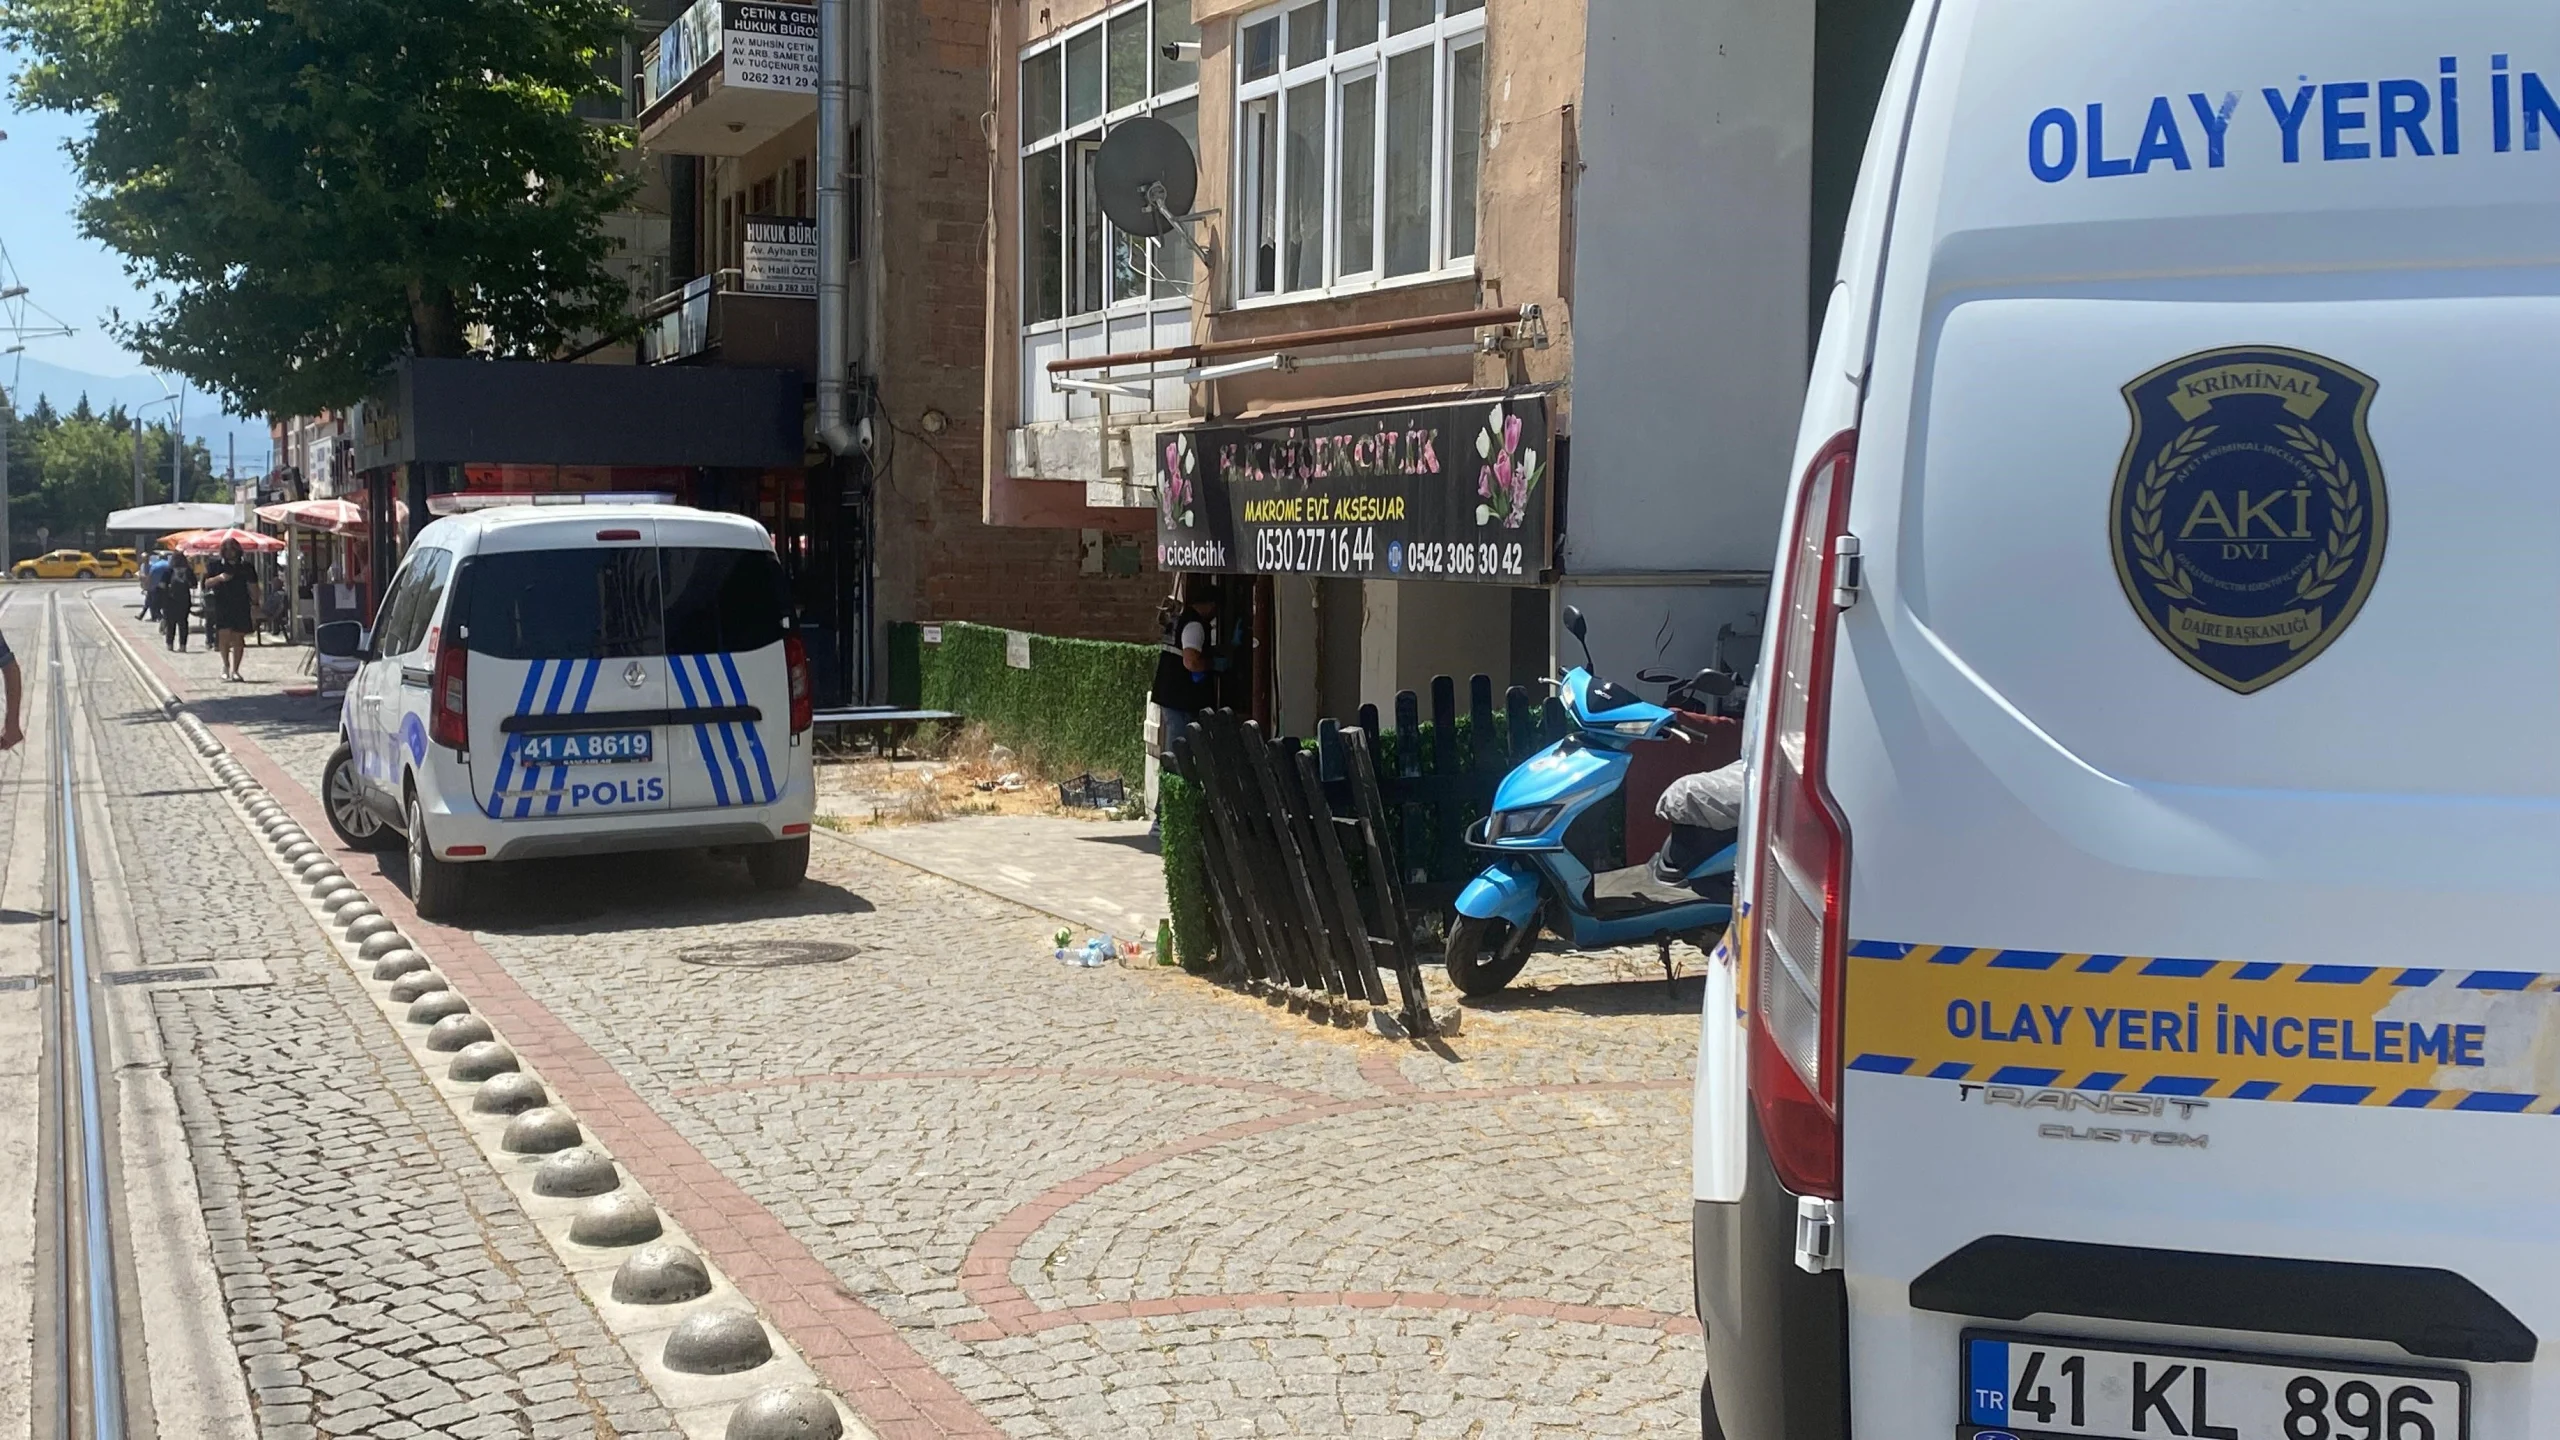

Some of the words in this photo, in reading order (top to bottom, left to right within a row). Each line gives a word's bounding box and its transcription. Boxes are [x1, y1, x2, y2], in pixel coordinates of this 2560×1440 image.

[734, 20, 777, 34] HUKUK
[741, 6, 776, 20] ÇETİN
[779, 11, 788, 22] &
[790, 12, 818, 24] GEN
[732, 36, 746, 46] AV.
[749, 38, 784, 50] MUHSİN
[787, 42, 814, 52] ÇETİN
[748, 49, 770, 58] ARB.
[773, 51, 804, 62] SAMET
[732, 58, 746, 66] AV.
[749, 58, 800, 71] TUĞÇENUR
[742, 72, 768, 83] 0262
[772, 75, 791, 85] 321
[795, 76, 808, 87] 29
[2028, 89, 2244, 184] OLAY
[2262, 56, 2459, 164] YERİ
[747, 223, 785, 242] HUKUK
[750, 246, 764, 254] Av.
[767, 246, 798, 257] Ayhan
[801, 248, 817, 257] ER
[750, 264, 764, 274] Av.
[768, 265, 790, 274] Halil
[2184, 369, 2312, 398] KRİMİNAL
[1244, 498, 1302, 522] MAKROME
[1306, 493, 1329, 521] EVİ
[1334, 496, 1405, 521] AKSESUAR
[2179, 480, 2312, 538] AKİ
[1167, 540, 1226, 567] cicekcihk
[1256, 528, 1292, 571] 0530
[1296, 528, 1325, 571] 277
[1330, 527, 1349, 572] 16
[1353, 526, 1374, 571] 44
[1408, 542, 1443, 572] 0542
[1447, 543, 1474, 574] 306
[1479, 543, 1498, 574] 30
[1502, 543, 1522, 575] 42
[2222, 544, 2268, 560] DVI
[2181, 618, 2223, 638] DAİRE
[2225, 617, 2309, 643] BAŞKANLIĞI
[524, 738, 551, 758] 41
[563, 737, 580, 756] A
[588, 735, 647, 755] 8619
[1947, 998, 2074, 1046] OLAY
[2084, 1002, 2198, 1054] YERİ
[2216, 1003, 2486, 1066] İNCELEME
[1958, 1084, 2210, 1120] TRANSIT
[2038, 1124, 2210, 1148] CUSTOM
[1976, 1389, 2004, 1410] TR
[2012, 1352, 2085, 1426] 41
[2132, 1361, 2238, 1440] KL
[2284, 1376, 2437, 1440] 896
